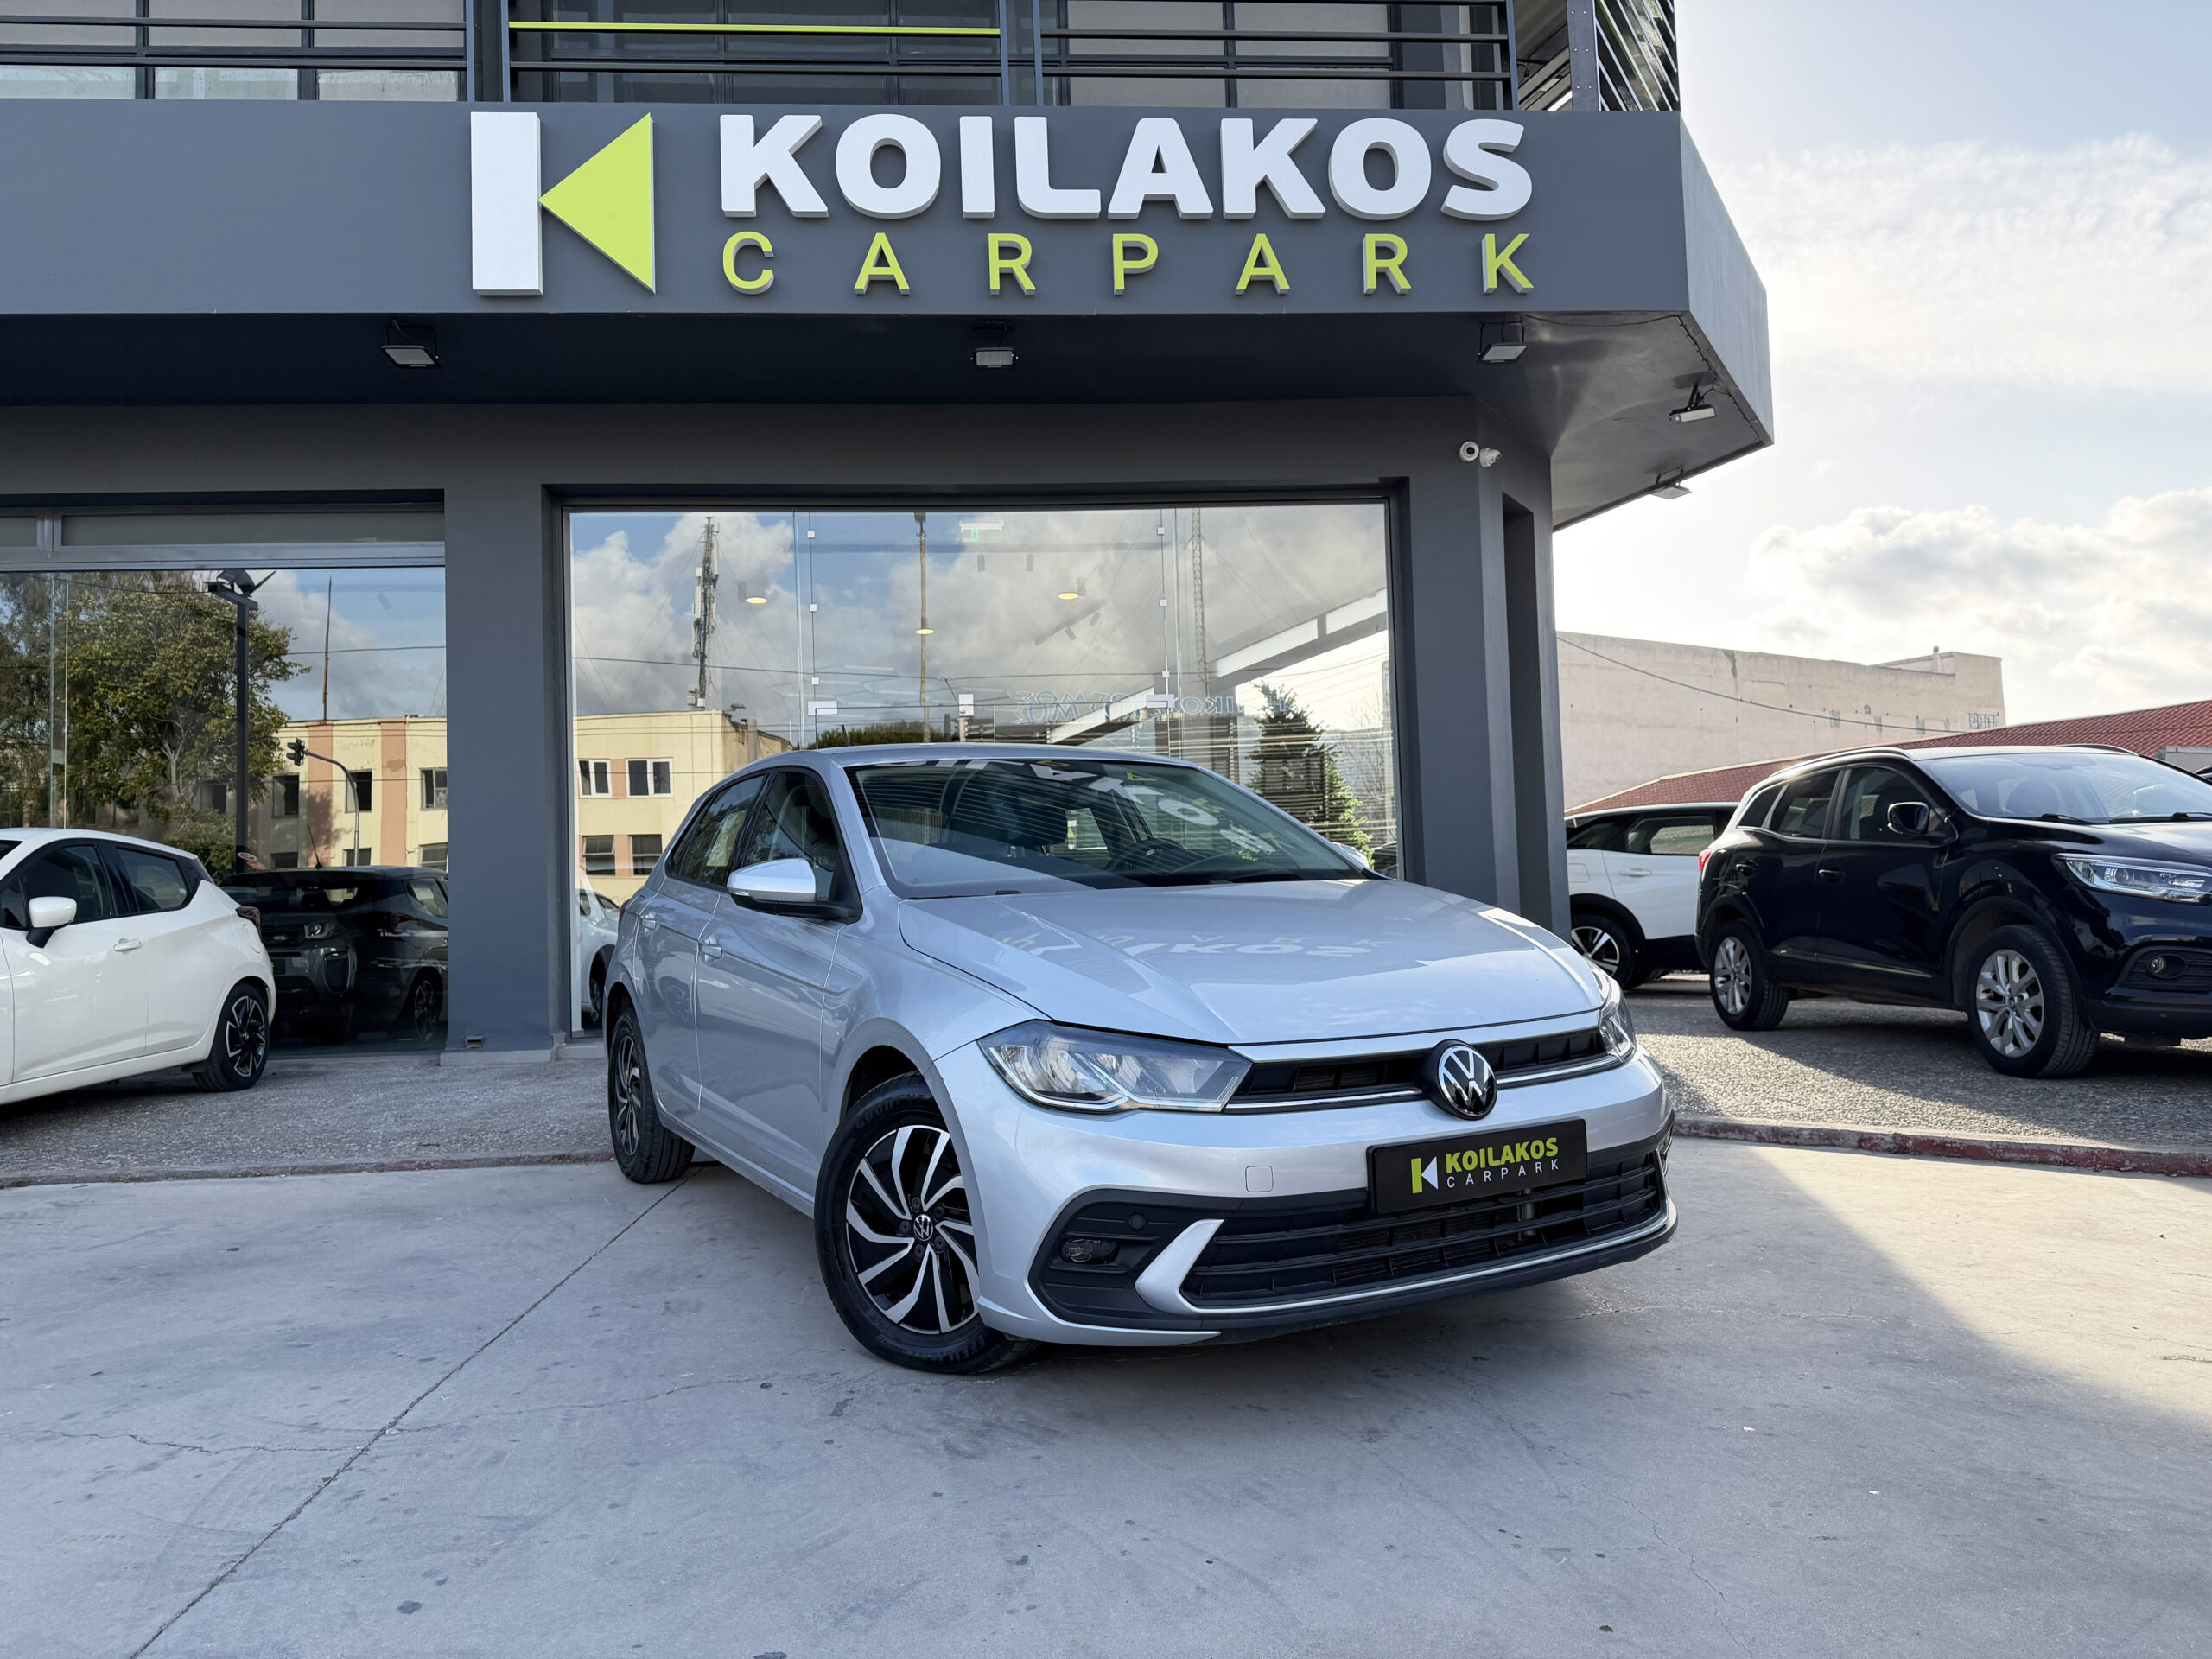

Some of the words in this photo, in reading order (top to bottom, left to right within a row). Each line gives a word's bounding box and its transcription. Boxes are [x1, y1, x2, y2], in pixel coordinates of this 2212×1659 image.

[719, 113, 1533, 221] KOILAKOS
[722, 231, 1534, 296] CARPARK
[1446, 1137, 1559, 1174] KOILAKOS
[1446, 1158, 1559, 1188] CARPARK
